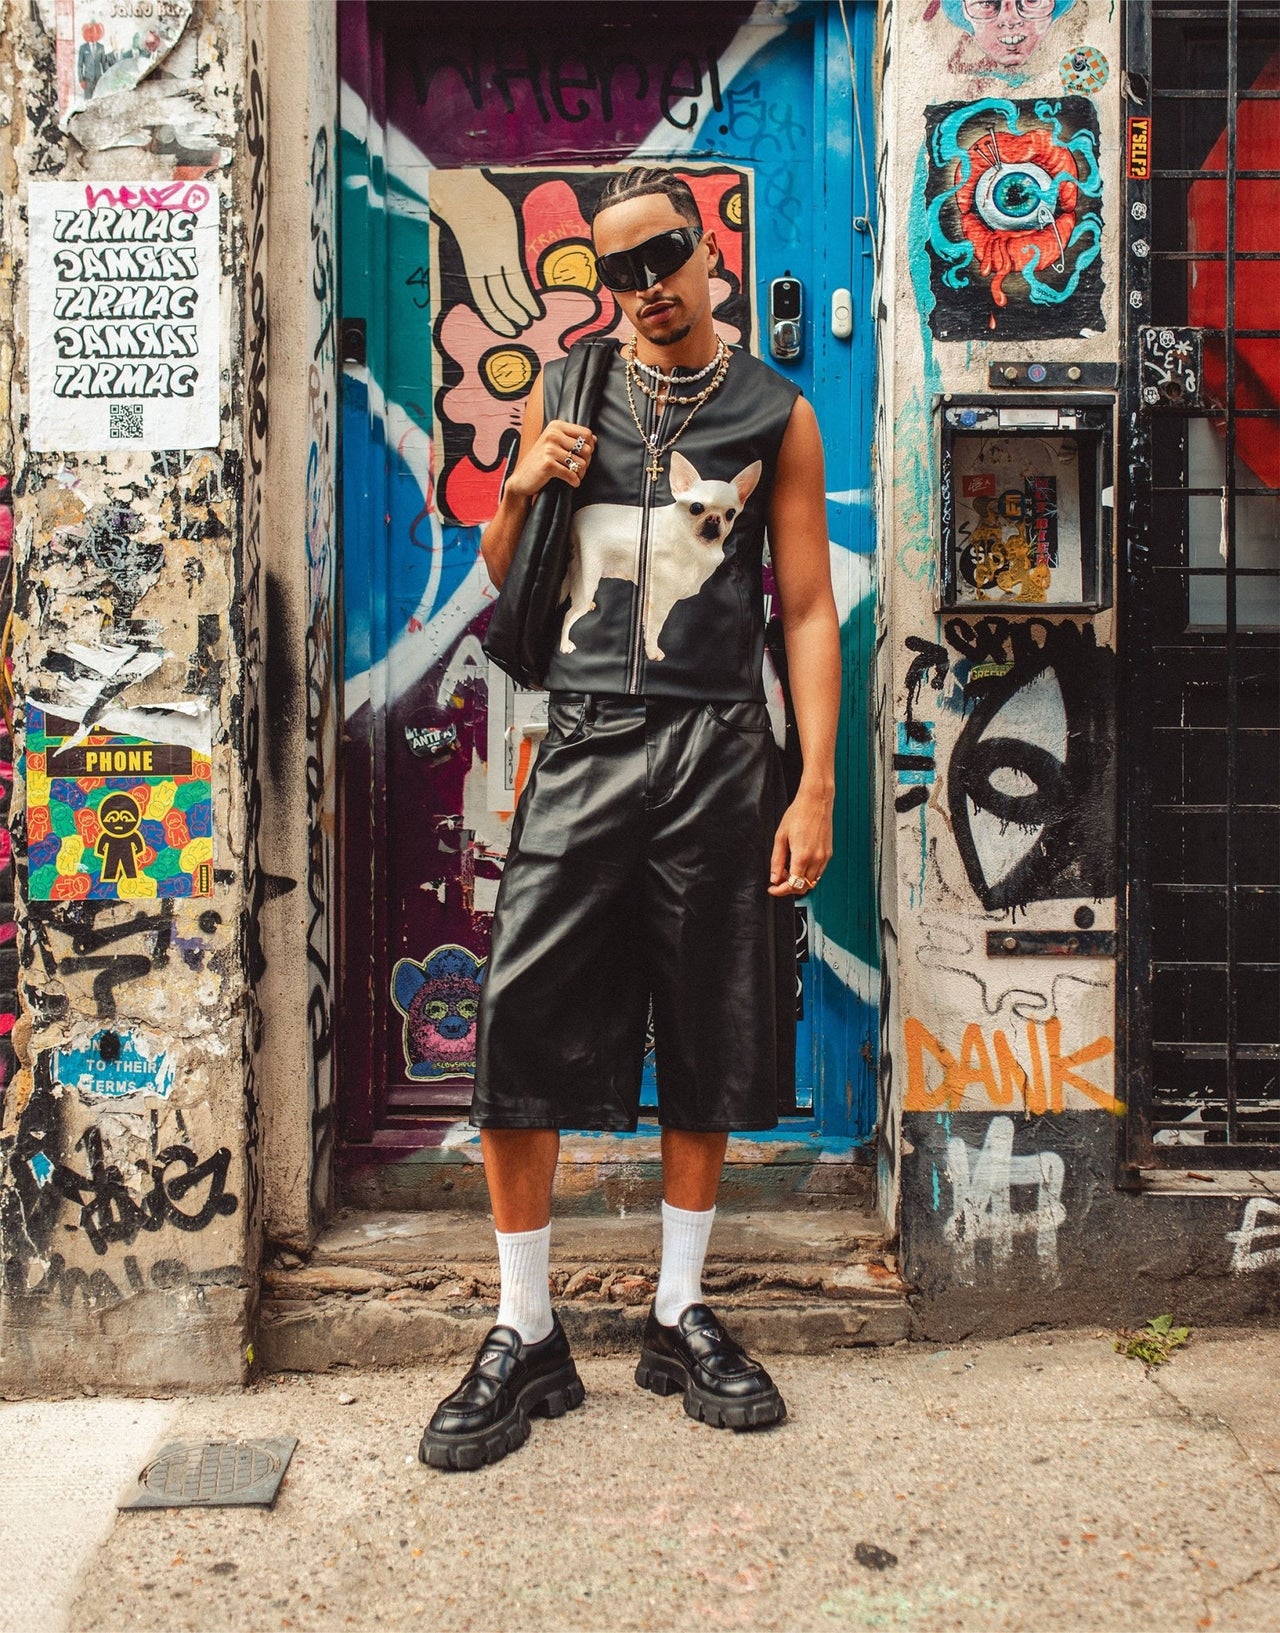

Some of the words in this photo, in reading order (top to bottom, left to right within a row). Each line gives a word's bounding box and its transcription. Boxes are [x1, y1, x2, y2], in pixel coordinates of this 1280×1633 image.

[1132, 121, 1148, 177] Y'SELF?
[53, 207, 199, 243] TARMAC
[53, 285, 199, 320] TARMAC
[53, 362, 199, 398] TARMAC
[86, 751, 153, 772] PHONE
[87, 1059, 106, 1072] TO
[114, 1060, 157, 1074] THEIR
[904, 1016, 1126, 1115] DANK
